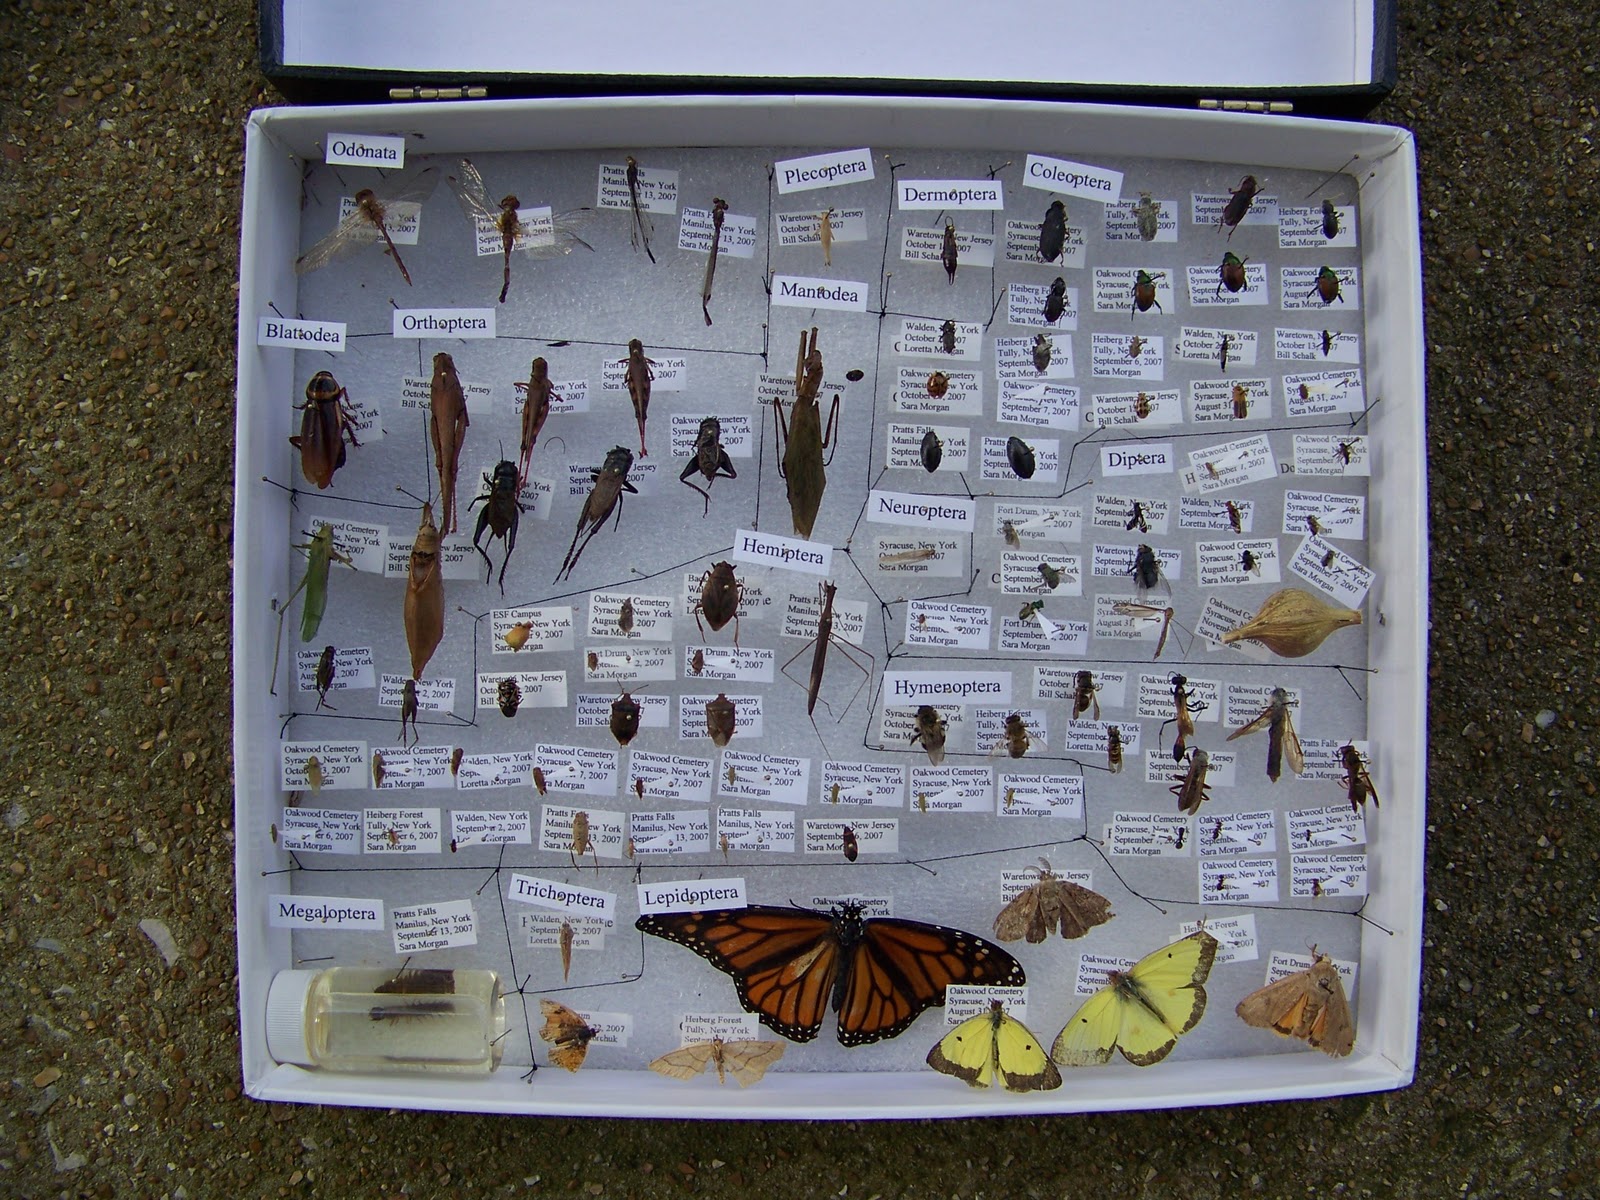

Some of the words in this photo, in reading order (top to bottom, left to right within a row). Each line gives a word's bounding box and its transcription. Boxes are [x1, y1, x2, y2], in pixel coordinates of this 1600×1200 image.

[332, 141, 396, 160] Odonata
[603, 166, 625, 175] Pratts
[785, 160, 867, 184] Plecoptera
[1030, 162, 1111, 191] Coleoptera
[658, 181, 676, 190] York
[658, 192, 676, 200] 2007
[905, 188, 997, 205] Dermoptera
[841, 210, 863, 218] Jersey
[1279, 208, 1307, 216] Heiberg
[738, 226, 756, 236] York
[781, 225, 810, 233] October
[1299, 239, 1327, 248] Morgan
[1096, 269, 1131, 277] Oakwood
[781, 282, 858, 302] Mantodea
[403, 315, 486, 333] Orthoptera
[266, 323, 339, 343] Blattodea
[960, 325, 979, 334] York
[1093, 335, 1123, 345] Heiberg
[1237, 332, 1255, 341] York
[904, 344, 936, 353] Loretta
[1183, 350, 1210, 359] Loretta
[1292, 352, 1316, 360] Schalk
[1093, 356, 1133, 366] September
[1094, 367, 1110, 375] Sara
[1112, 367, 1141, 377] Morgan
[1285, 372, 1321, 384] Oakwood
[1322, 370, 1357, 381] Cemetery
[1194, 381, 1229, 390] Oakwood
[1251, 389, 1269, 397] York
[1002, 402, 1042, 415] September
[1052, 407, 1070, 416] 2007
[1195, 403, 1221, 412] August
[1308, 405, 1336, 414] Morgan
[1001, 412, 1018, 421] Sara
[1019, 414, 1049, 425] Morgan
[731, 426, 751, 434] York
[1109, 452, 1166, 469] Diptera
[879, 498, 966, 521] Neuroptera
[346, 522, 380, 536] Cemetery
[918, 541, 936, 549] New
[938, 541, 957, 549] York
[1199, 542, 1235, 552] Oakwood
[743, 537, 823, 564] Hemiptera
[1003, 553, 1039, 562] Oakwood
[1041, 554, 1076, 565] Cemetery
[1220, 575, 1249, 584] Morgan
[633, 597, 671, 609] Cemetery
[911, 602, 948, 611] Oakwood
[950, 604, 987, 616] Cemetery
[493, 611, 509, 619] ESF
[511, 610, 542, 619] Campus
[552, 619, 571, 627] York
[545, 630, 563, 638] 2007
[335, 648, 370, 656] Cemetery
[733, 649, 751, 657] New
[754, 650, 773, 659] York
[895, 680, 1001, 698] Hymenoptera
[1300, 739, 1318, 747] Pratts
[1321, 739, 1338, 747] Falls
[284, 745, 321, 753] Oakwood
[323, 745, 360, 754] Cemetery
[538, 745, 575, 756] Oakwood
[577, 749, 614, 761] Cemetery
[633, 752, 670, 763] Oakwood
[672, 756, 710, 769] Cemetery
[671, 767, 689, 775] New
[692, 769, 711, 778] York
[912, 768, 950, 776] Oakwood
[951, 768, 989, 777] Cemetery
[1004, 774, 1041, 783] Oakwood
[1043, 775, 1080, 786] Cemetery
[285, 809, 321, 818] Oakwood
[323, 811, 359, 822] Cemetery
[366, 811, 397, 820] Heiberg
[489, 813, 506, 821] New
[509, 812, 528, 820] York
[719, 809, 740, 817] Pratts
[743, 809, 761, 817] Falls
[1003, 807, 1019, 815] Sara
[1022, 807, 1051, 818] Morgan
[1115, 814, 1151, 822] Oakwood
[1155, 815, 1187, 824] Cemetery
[412, 821, 432, 829] York
[668, 823, 686, 831] New
[689, 822, 708, 830] York
[871, 821, 895, 830] Jersey
[285, 840, 301, 849] Sara
[303, 841, 332, 851] Morgan
[367, 843, 384, 851] Sara
[386, 843, 416, 852] Morgan
[1293, 855, 1328, 863] Oakwood
[1330, 854, 1364, 863] Cemetery
[1202, 860, 1237, 870] Oakwood
[1238, 859, 1273, 868] Cemetery
[517, 879, 604, 908] Trichoptera
[645, 888, 739, 907] Lepidoptera
[279, 903, 376, 923] Megaloptera
[393, 911, 416, 919] Pratts
[418, 907, 437, 916] Falls
[431, 917, 449, 925] New
[451, 914, 471, 923] York
[1215, 920, 1238, 929] Forest
[453, 924, 472, 934] 2007
[418, 940, 448, 950] Morgan
[988, 987, 1024, 996] Cemetery
[718, 1016, 742, 1024] Forest
